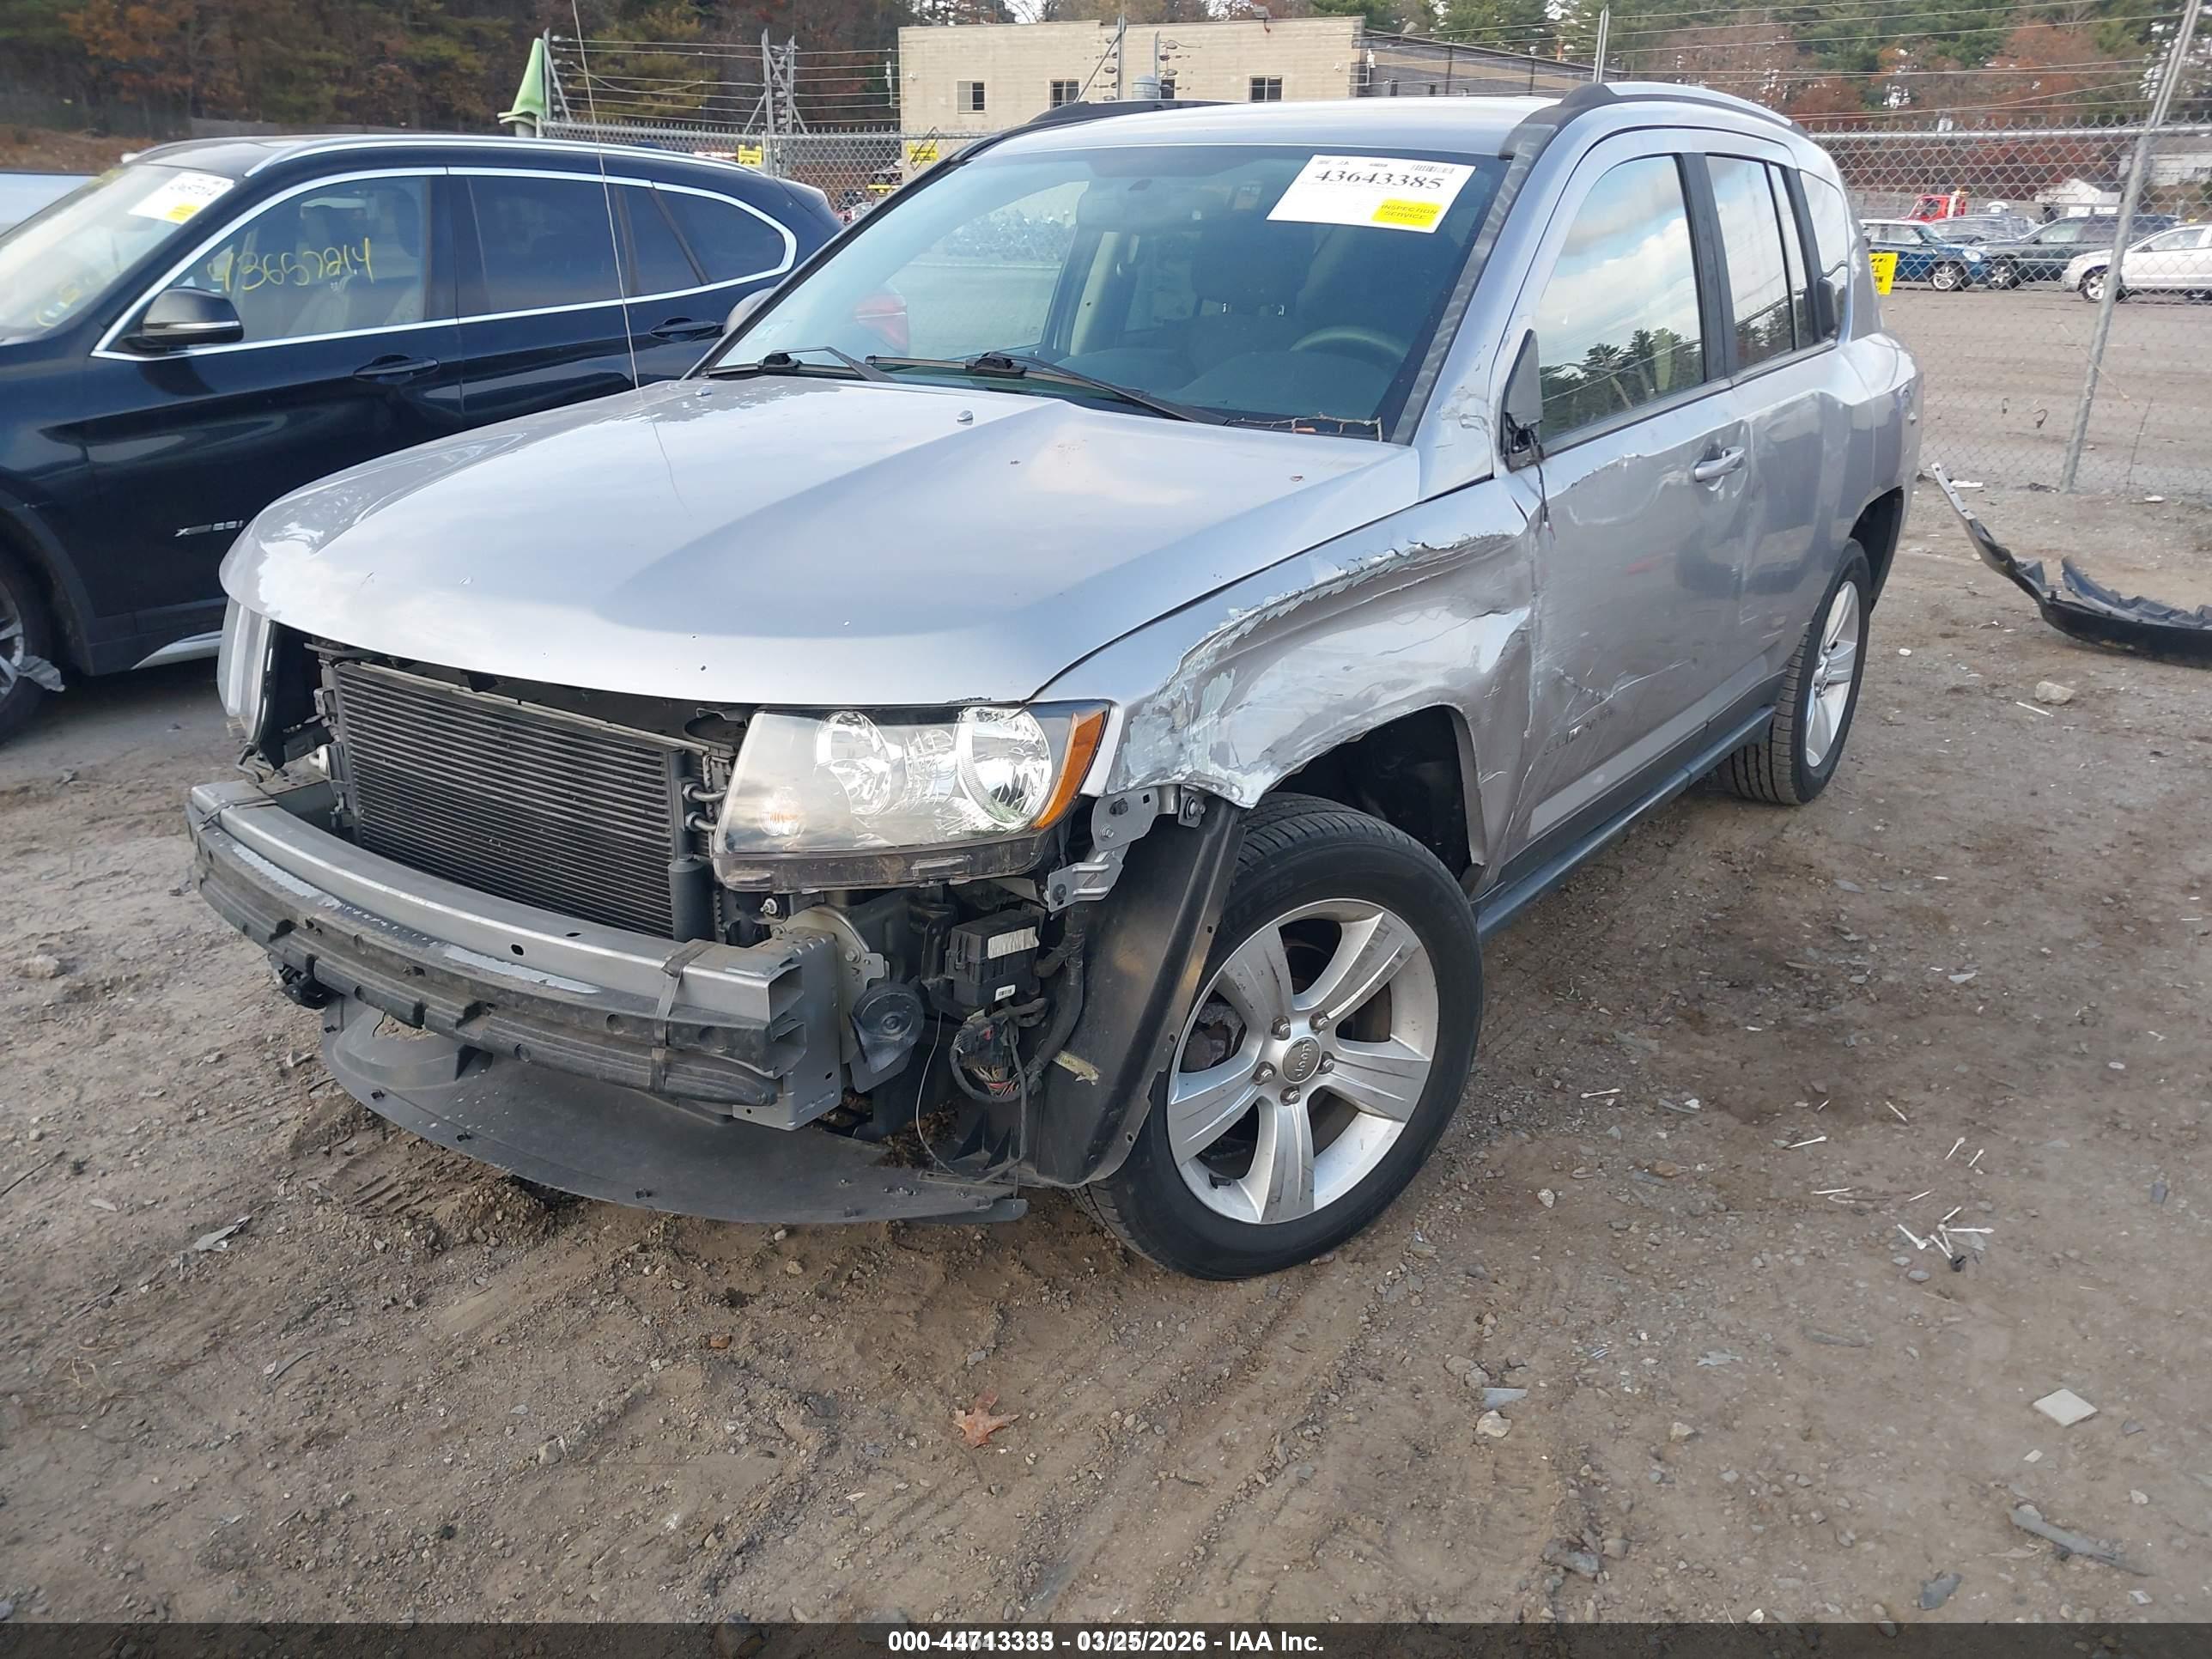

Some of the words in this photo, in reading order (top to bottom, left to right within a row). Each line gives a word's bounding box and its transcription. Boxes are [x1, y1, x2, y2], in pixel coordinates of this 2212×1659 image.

[1315, 170, 1445, 190] 43643385
[1381, 204, 1438, 216] INSPECTION
[1384, 210, 1428, 221] SERVICE
